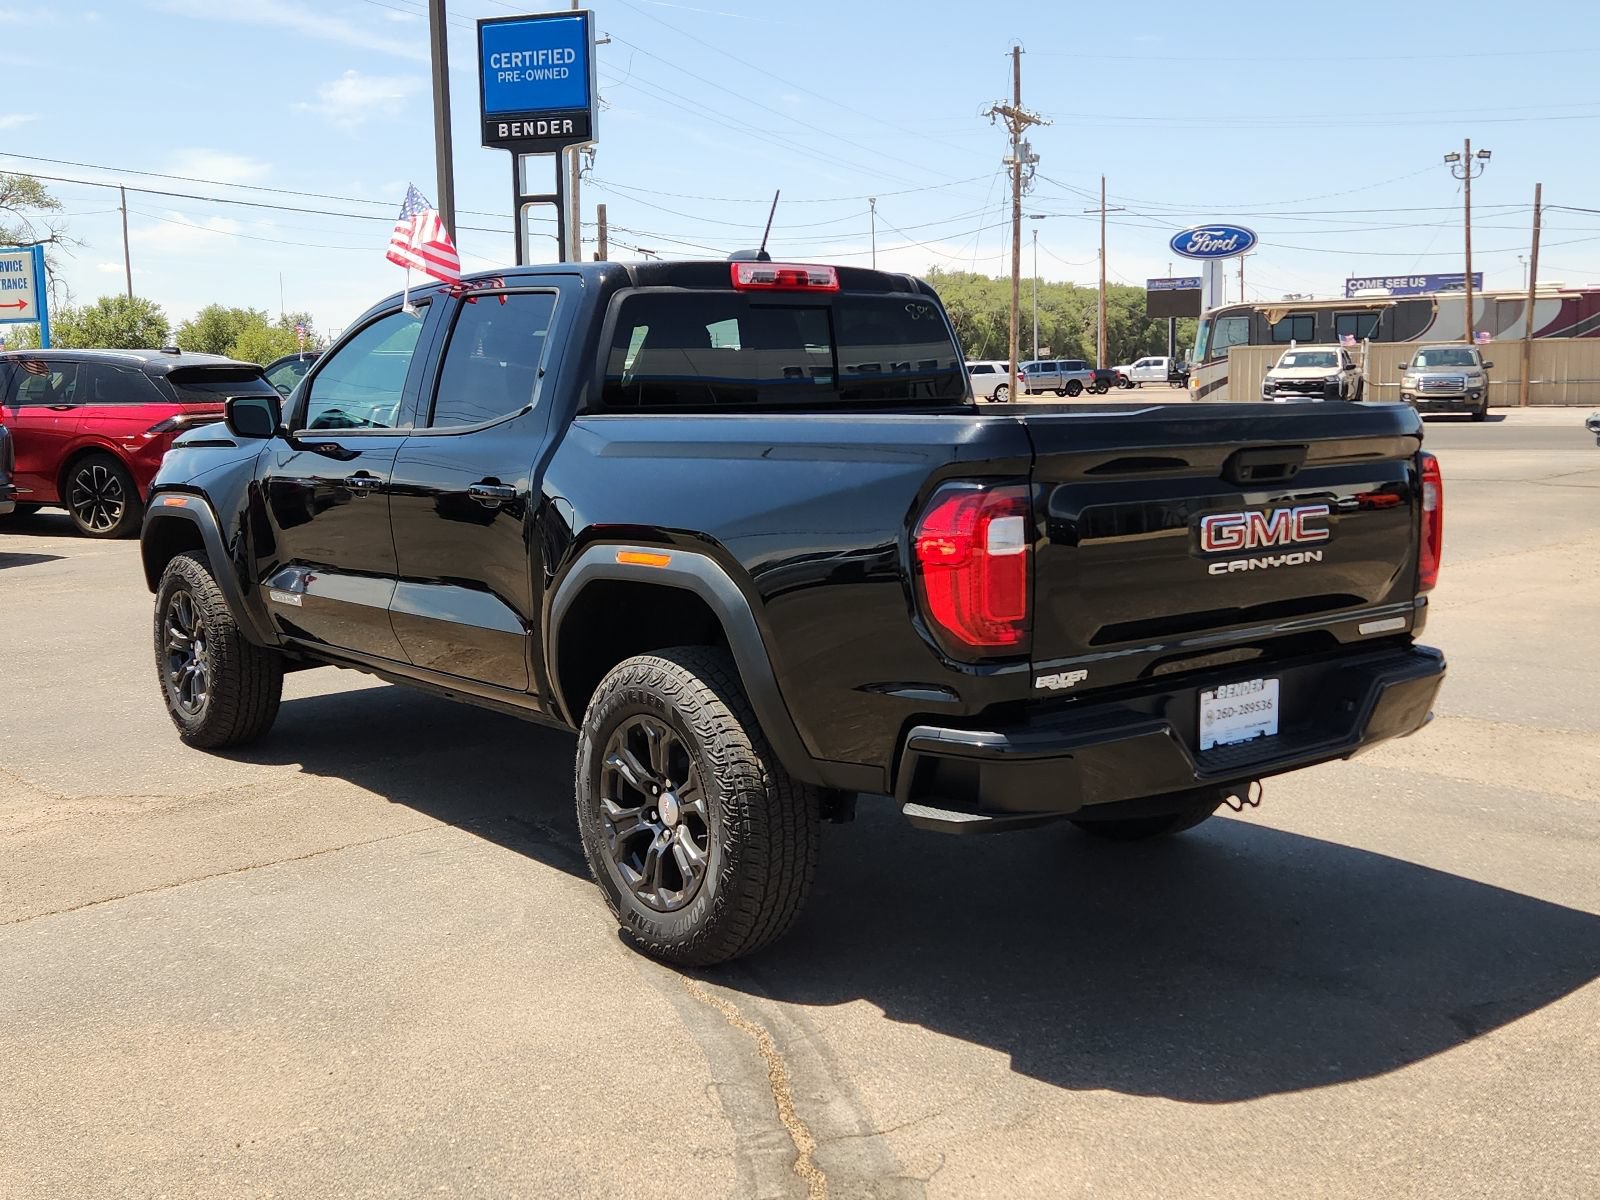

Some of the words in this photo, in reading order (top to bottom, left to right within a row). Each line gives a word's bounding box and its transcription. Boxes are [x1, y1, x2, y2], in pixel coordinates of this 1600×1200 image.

[490, 48, 576, 69] CERTIFIED
[497, 67, 569, 83] PRE-OWNED
[498, 120, 573, 137] BENDER
[1186, 231, 1239, 253] Ford
[0, 277, 28, 291] RANCE
[1349, 279, 1384, 290] COME
[1385, 278, 1409, 289] SEE
[1409, 277, 1427, 287] US
[1201, 504, 1330, 552] GMC
[1208, 550, 1323, 575] CANYON
